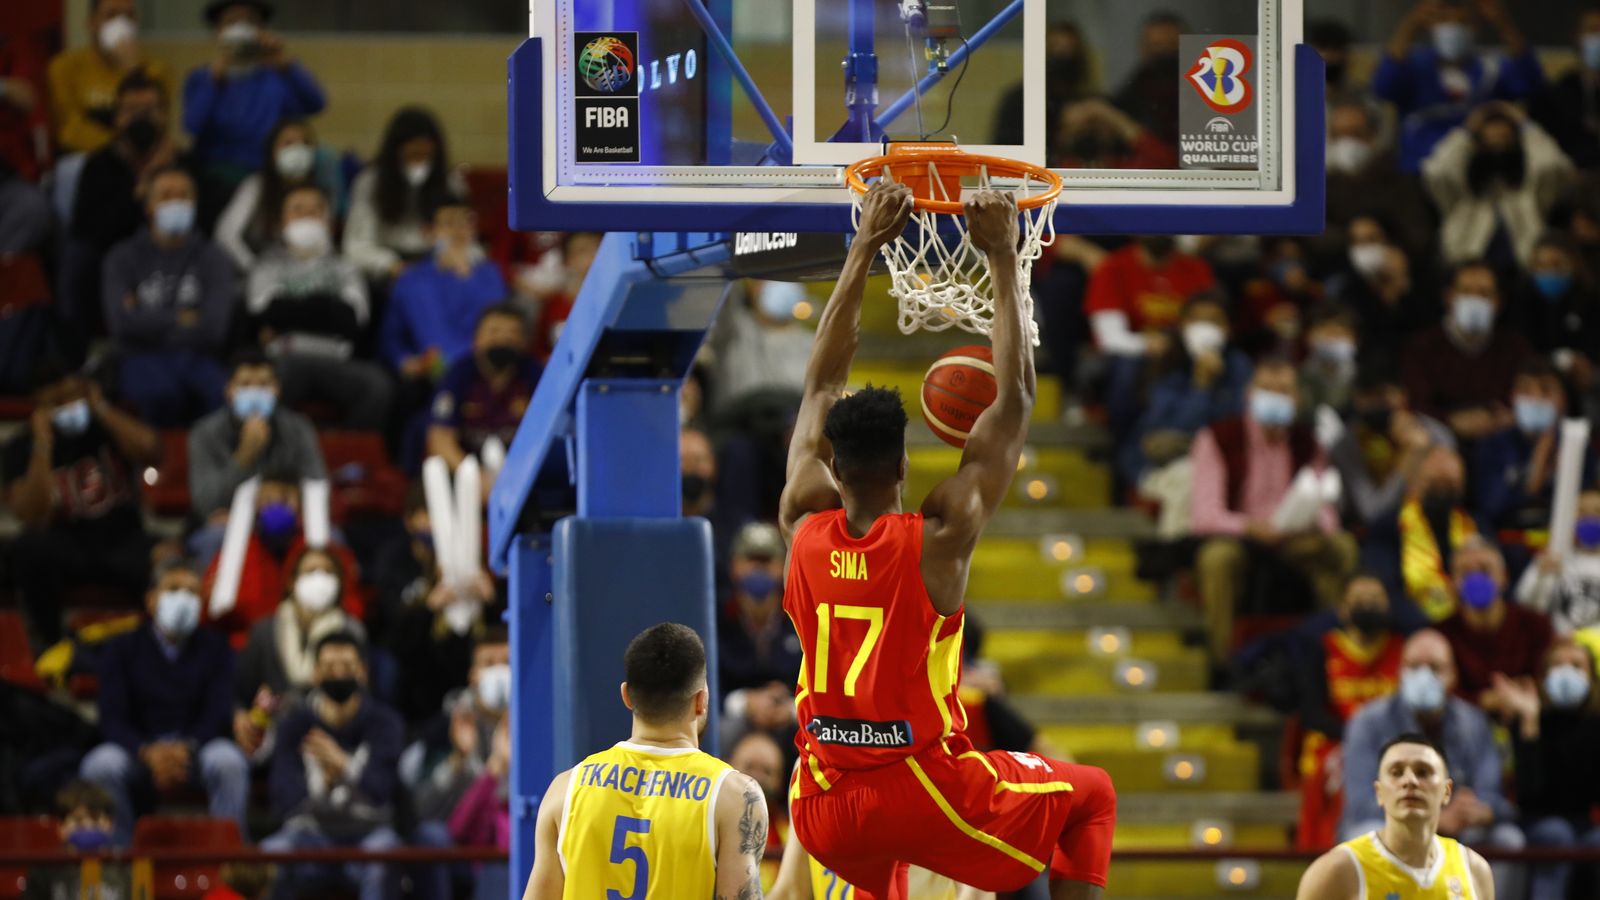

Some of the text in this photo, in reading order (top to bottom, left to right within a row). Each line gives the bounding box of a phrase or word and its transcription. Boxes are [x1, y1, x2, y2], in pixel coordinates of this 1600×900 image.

[585, 106, 629, 128] FIBA
[1211, 123, 1229, 132] FIBA
[582, 146, 633, 154] We Are Basketball
[1181, 141, 1258, 152] WORLD CUP
[1182, 154, 1257, 165] QUALIFIERS
[830, 550, 868, 580] SIMA
[814, 602, 884, 697] 17
[812, 718, 908, 745] CaixaBank
[579, 762, 712, 801] TKACHENKO
[606, 815, 651, 900] 5
